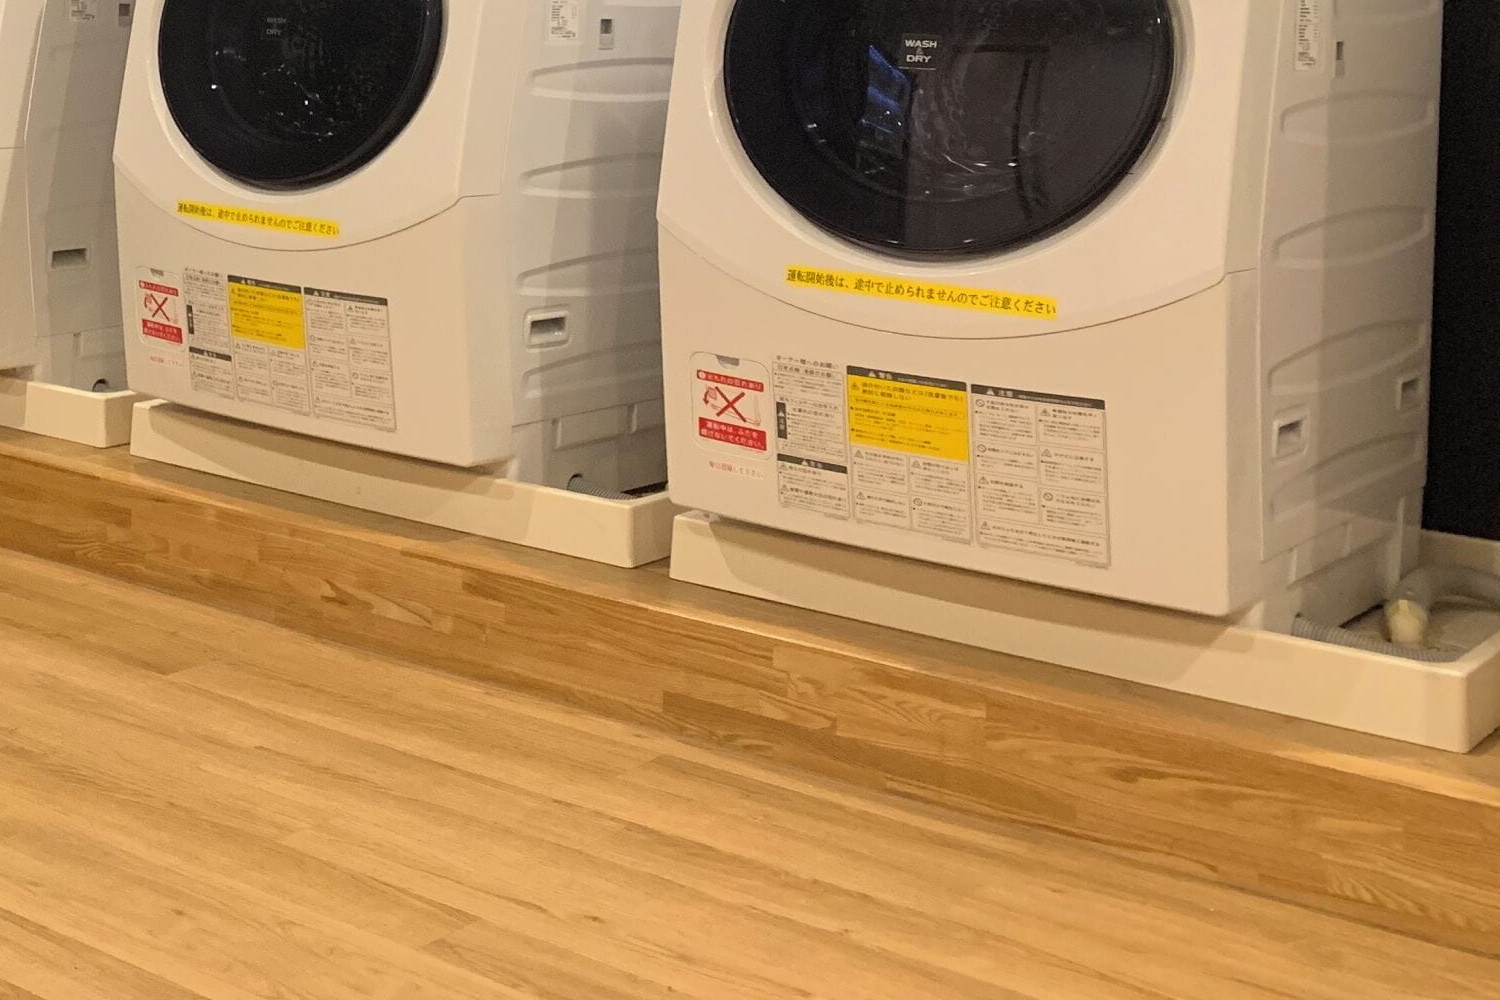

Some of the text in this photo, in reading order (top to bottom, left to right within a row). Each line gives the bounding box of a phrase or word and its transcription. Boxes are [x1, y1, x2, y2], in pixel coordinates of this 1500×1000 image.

[905, 40, 937, 48] WASH
[786, 269, 1057, 314] 運転開始後は、途中で止められませんのでご注意ください
